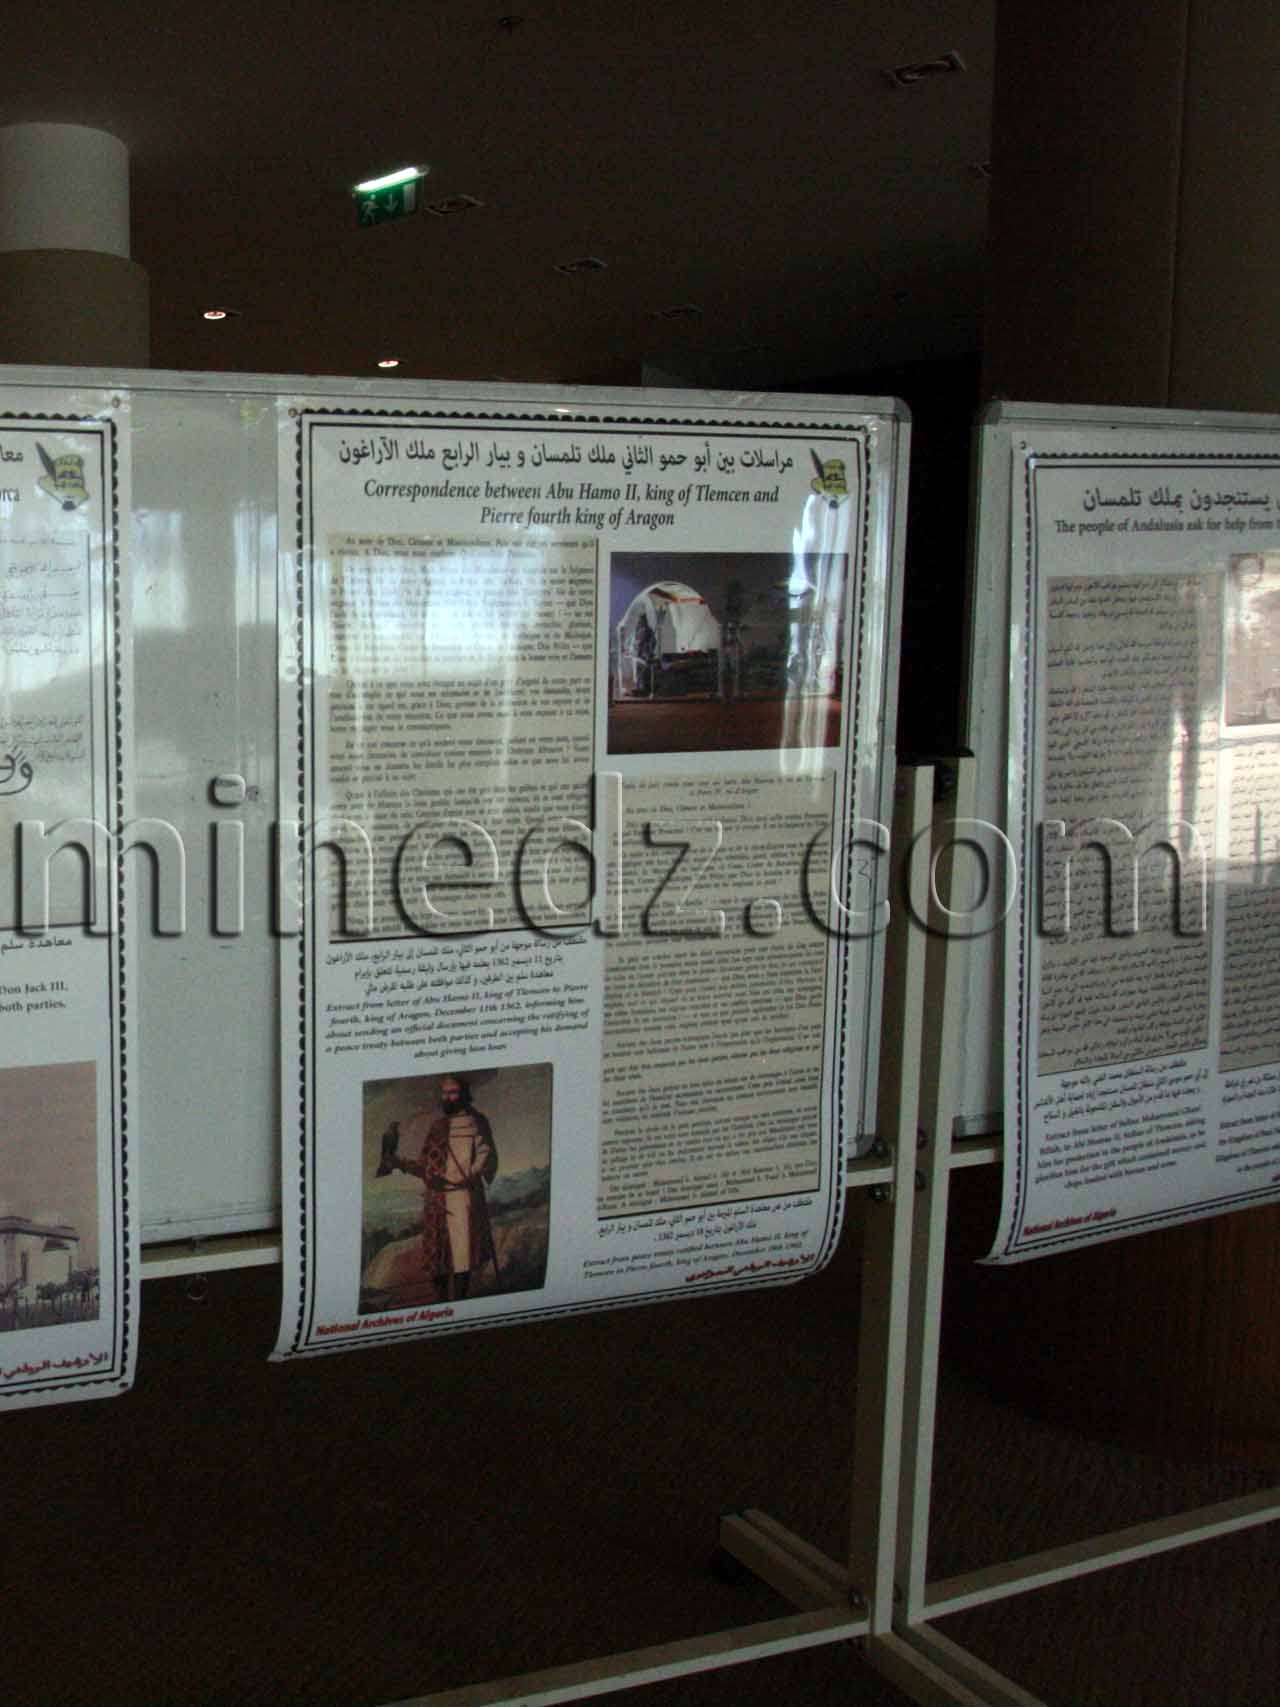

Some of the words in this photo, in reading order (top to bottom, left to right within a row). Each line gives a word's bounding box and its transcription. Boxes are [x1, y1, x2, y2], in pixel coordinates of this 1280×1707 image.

[406, 439, 435, 460] ملك
[442, 441, 478, 470] الرابع
[486, 442, 510, 468] بيار
[517, 451, 524, 467] و
[531, 442, 581, 466] تلمسان
[588, 445, 615, 462] ملك
[622, 446, 652, 474] الثاني
[694, 441, 710, 472] أبو
[659, 454, 688, 472] حمو
[717, 452, 734, 473] بين
[740, 450, 792, 474] مراسلات
[364, 480, 480, 502] Correspondence
[485, 481, 541, 499] between
[546, 482, 574, 499] Abu
[579, 483, 620, 500] Hamo
[625, 483, 640, 501] II,
[646, 485, 674, 505] king
[678, 484, 693, 506] of
[696, 485, 749, 502] Tlemcen
[754, 486, 779, 502] and
[1084, 488, 1141, 510] تلمسان
[1150, 488, 1183, 512] بملك
[1191, 489, 1269, 511] يستنجدون
[480, 507, 524, 524] Pierre
[527, 506, 570, 527] fourth
[576, 508, 604, 528] king
[609, 508, 624, 530] of
[626, 509, 674, 530] Aragon
[1056, 520, 1075, 532] The
[1079, 518, 1114, 535] people
[1118, 518, 1129, 532] of
[1206, 518, 1220, 530] for
[1225, 518, 1245, 533] help
[29, 939, 72, 951] معاهدة
[24, 981, 47, 994] Jack
